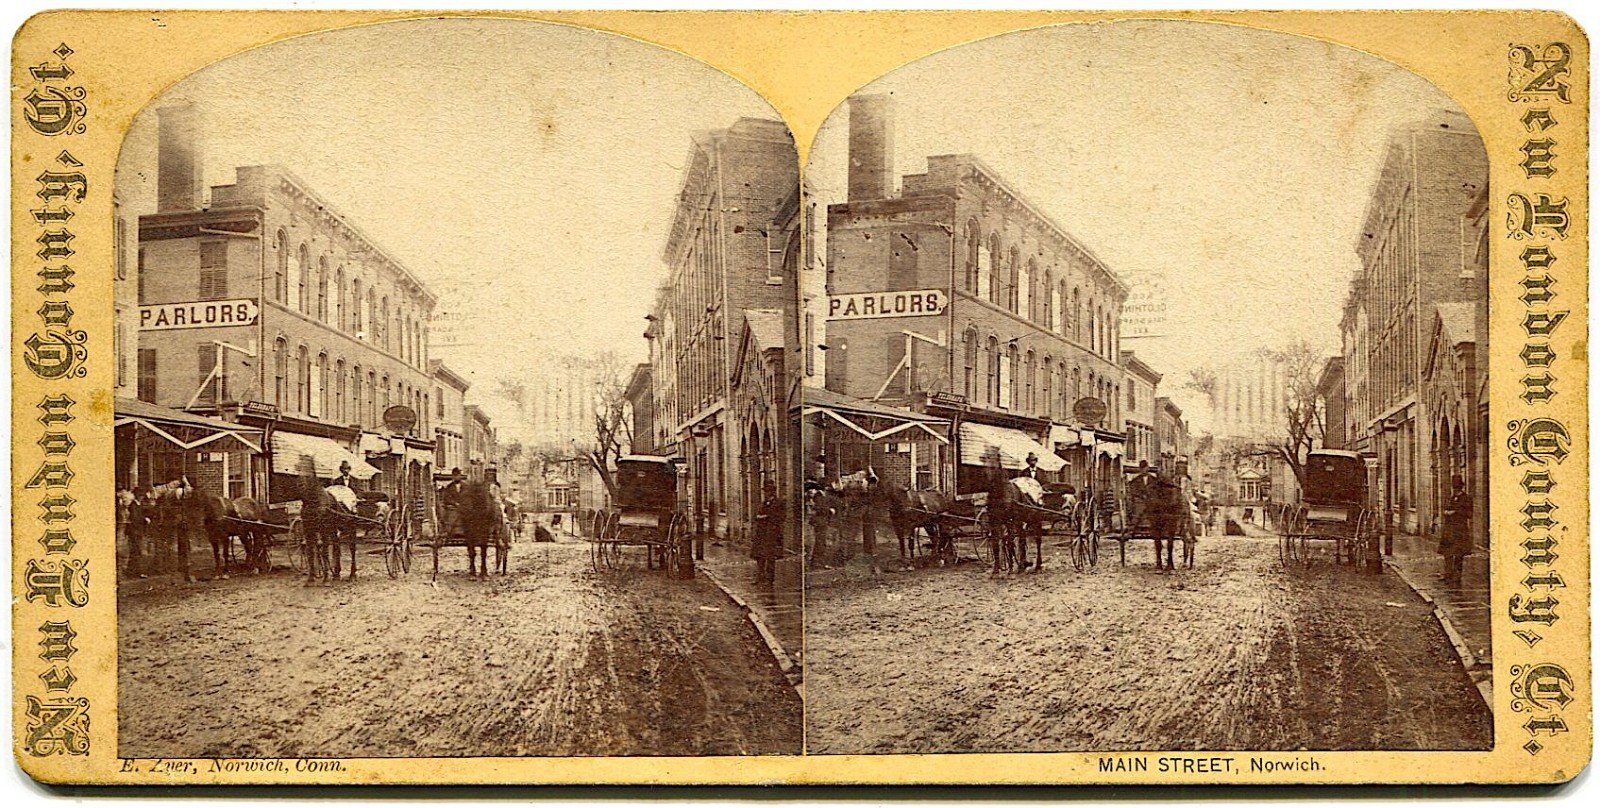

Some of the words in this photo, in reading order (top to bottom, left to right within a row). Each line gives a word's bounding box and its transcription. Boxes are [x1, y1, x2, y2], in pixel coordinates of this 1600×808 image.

[23, 41, 88, 137] Ct.
[1506, 41, 1573, 180] New
[23, 149, 88, 381] County,
[140, 302, 253, 327] PARLORS.
[829, 293, 942, 317] PARLORS.
[1505, 192, 1572, 406] London
[24, 393, 90, 609] London
[1506, 416, 1573, 649] County,
[25, 619, 90, 757] New
[1509, 661, 1575, 757] Ct.
[119, 758, 139, 773] E.
[207, 757, 290, 775] Norwich,
[295, 757, 348, 773] Conn.
[1098, 756, 1148, 773] MAIN
[1157, 756, 1240, 775] STREET,
[1250, 756, 1327, 773] Norwich.
